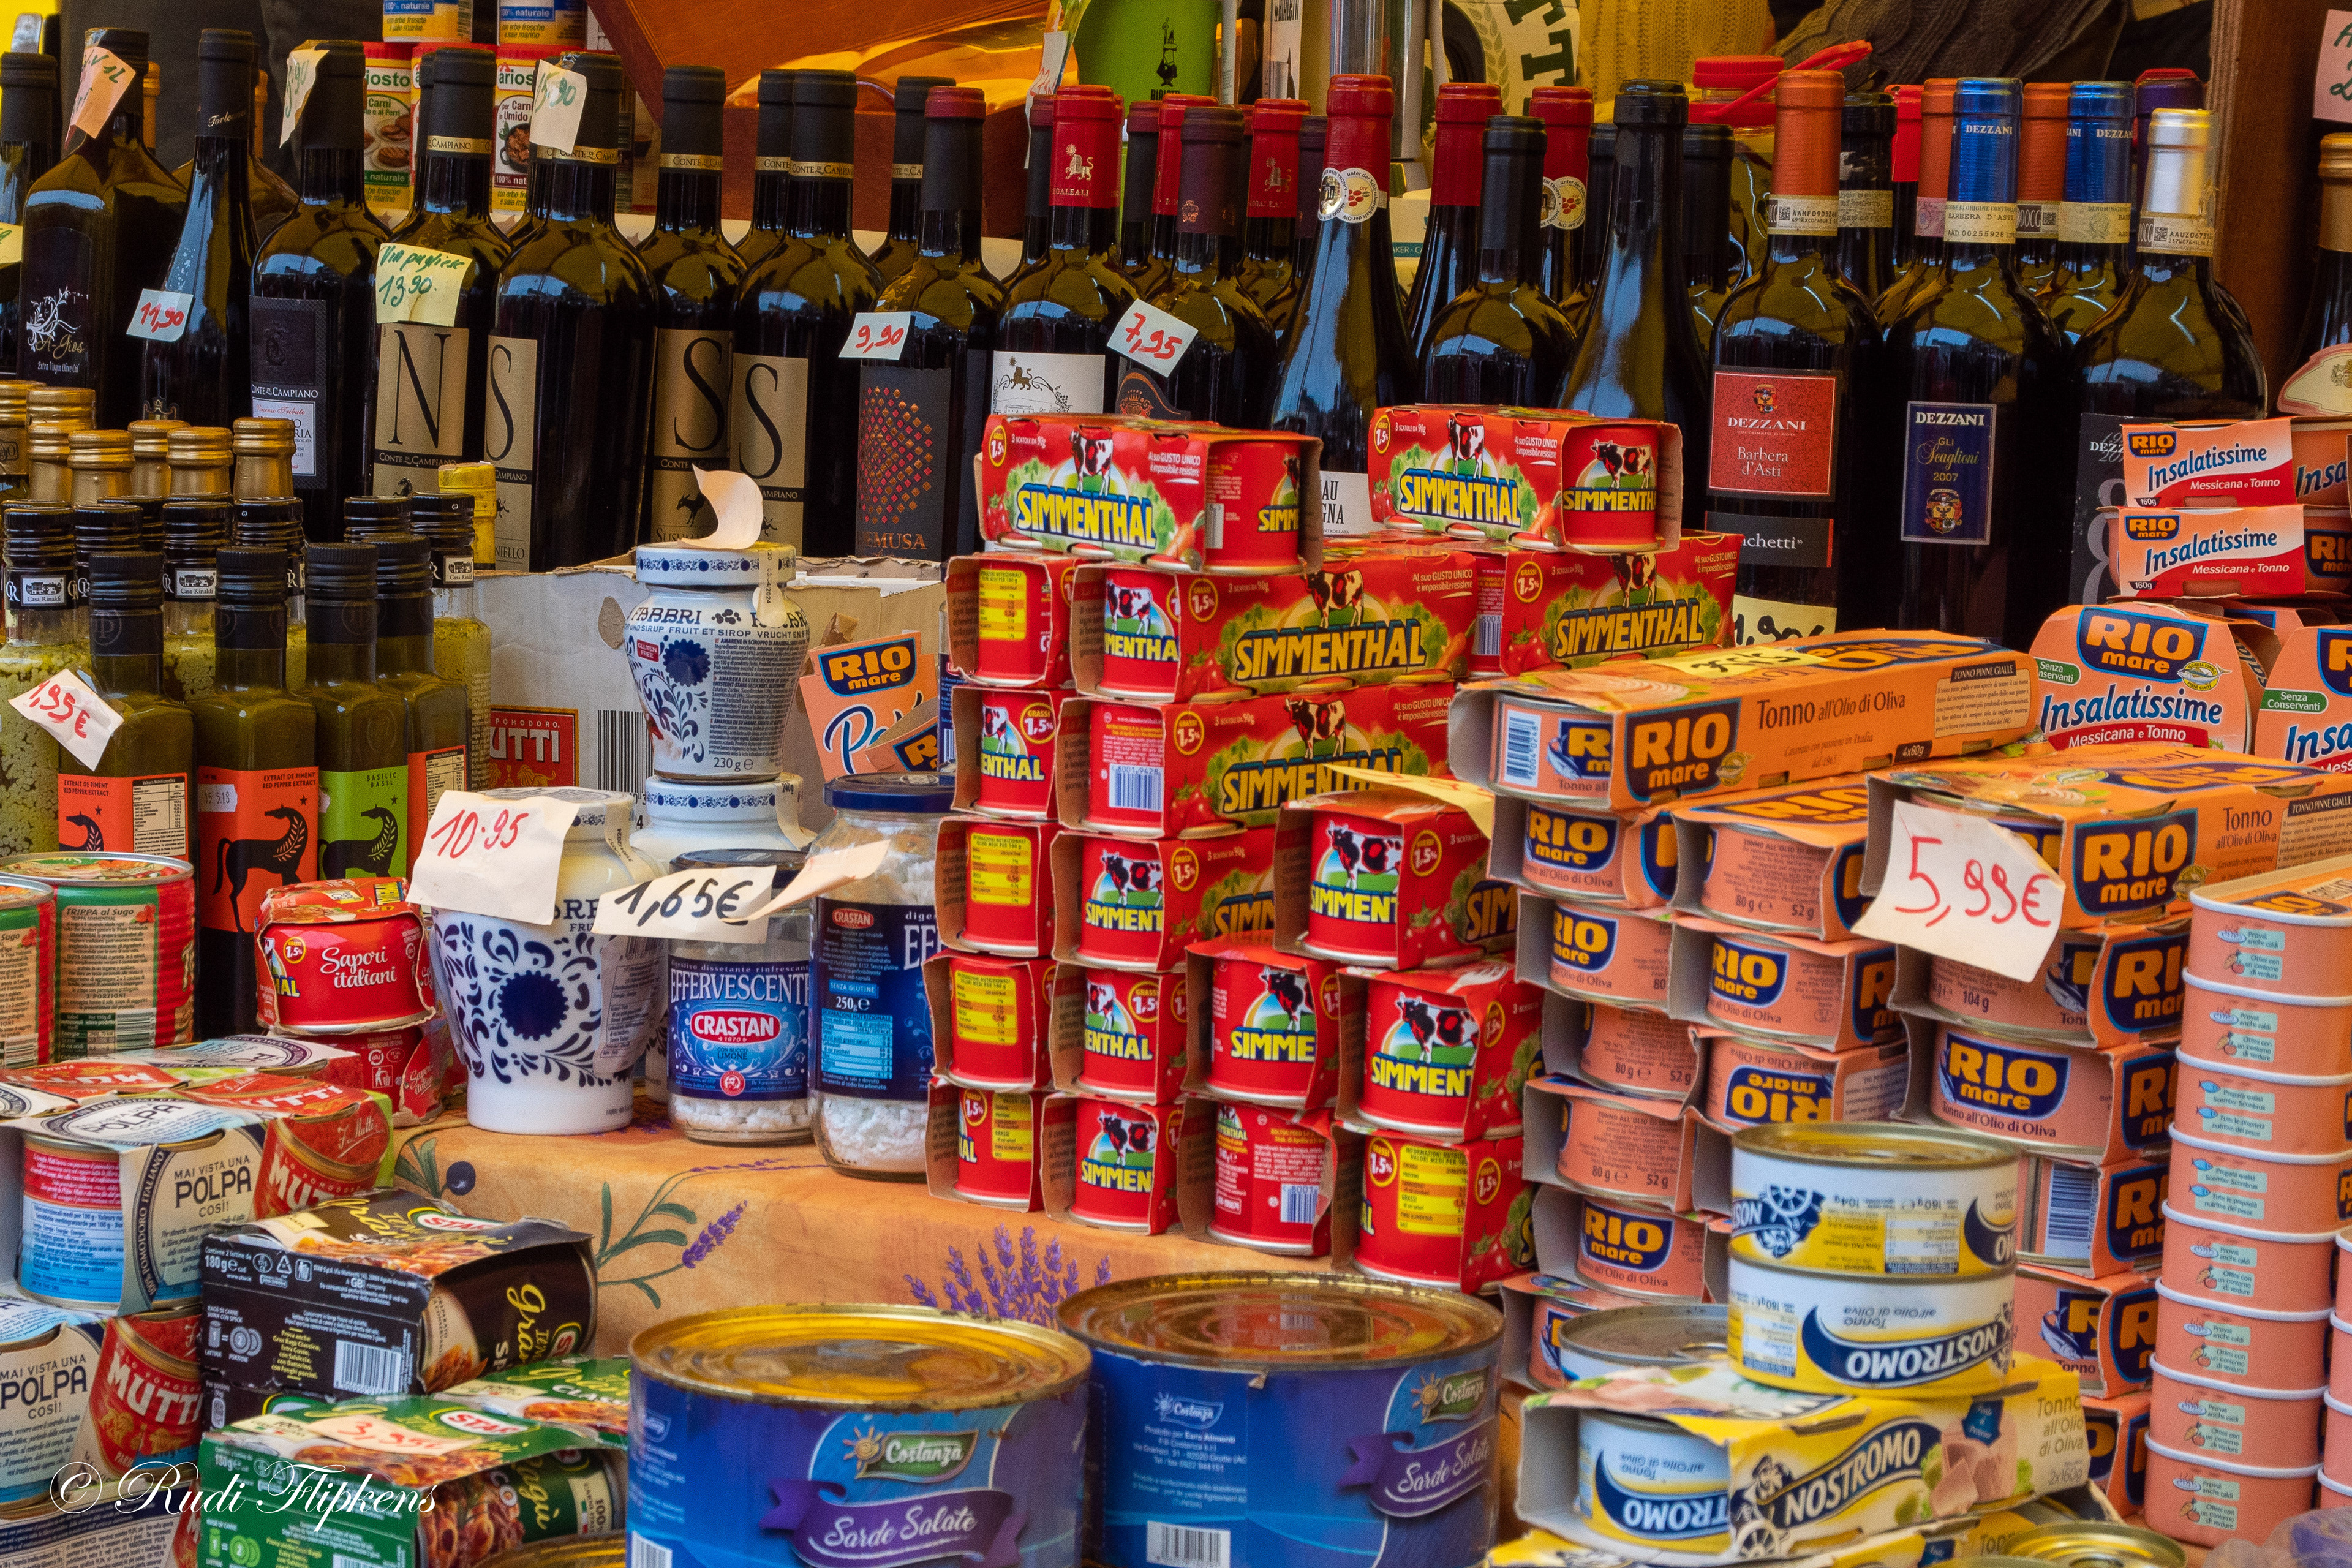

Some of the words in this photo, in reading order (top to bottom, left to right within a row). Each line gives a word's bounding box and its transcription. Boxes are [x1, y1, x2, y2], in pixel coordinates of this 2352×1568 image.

[516, 9, 549, 17] naturale
[369, 99, 391, 107] Carni
[1966, 124, 2013, 135] DEZZANI
[2097, 129, 2132, 138] DEZZAN
[673, 156, 701, 167] CONTE
[140, 301, 184, 330] 11,90
[856, 325, 904, 353] 9,90
[1125, 312, 1183, 360] 7,95
[251, 384, 265, 395] CONTE
[273, 387, 318, 398] CAMPIANO
[388, 328, 452, 448] N
[675, 337, 723, 452] S
[486, 344, 511, 461] S
[739, 363, 778, 479] S
[1728, 417, 1806, 431] DEZZANI
[1915, 412, 1985, 427] DEZZANI
[1917, 439, 1980, 466] Scaglioni
[1938, 437, 1954, 447] GLI
[2132, 435, 2174, 449] RIO
[2140, 447, 2167, 455] mare
[1738, 446, 1789, 463] Barbera
[1741, 462, 1782, 477] d'Asti
[1933, 472, 1959, 482] 2007
[2149, 443, 2267, 492] Insalatissime
[2190, 479, 2243, 490] Messicana
[2249, 478, 2280, 488] Tonno
[1400, 474, 1521, 527] SIMMENTHAL
[2139, 497, 2157, 506] 160g
[1016, 489, 1156, 549] SIMMENTHAL
[2129, 518, 2177, 532] RIO
[2138, 530, 2168, 538] mare
[2145, 527, 2277, 576] Insalatissime
[1432, 571, 1452, 580] GUSTO
[1453, 569, 1472, 579] UNICO
[2192, 564, 2250, 575] Messicana
[2257, 563, 2290, 573] Tonno
[1518, 577, 1539, 594] 1,5%
[2135, 581, 2153, 590] 160g
[627, 607, 701, 625] FABBRI
[1556, 602, 1703, 658] SIMMENTHAL
[2086, 616, 2195, 662] RIO
[638, 642, 657, 652] GLUTEN
[1235, 626, 1427, 680] SIMMENTHAL
[828, 646, 911, 682] RIO
[1954, 669, 1975, 679] TONNO
[1976, 668, 1994, 677] PINNE
[1994, 665, 2014, 675] GIALLE
[2040, 660, 2064, 673] Senza
[2101, 651, 2170, 674] mare
[848, 673, 901, 690] mare
[2040, 682, 2223, 734] Insalatissime
[2267, 700, 2320, 711] Conservanti
[2280, 692, 2307, 702] Senza
[1756, 698, 1816, 731] Tonno
[1819, 698, 1858, 722] all'Olio
[1858, 695, 1871, 715] di
[1873, 690, 1906, 712] Oliva
[1632, 711, 1733, 769] RIO
[2068, 728, 2135, 748] Messicana
[2146, 725, 2187, 741] Tonno
[1902, 745, 1924, 757] 4x80g
[714, 757, 733, 768] 230
[263, 774, 284, 782] EXTRAIT
[295, 772, 315, 780] PIMENT
[295, 778, 316, 787] EXTRACT
[367, 772, 398, 783] BASILIC
[371, 778, 393, 788] BASIL
[1648, 761, 1711, 790] mare
[2223, 807, 2272, 831] Tonno
[1531, 812, 1608, 851] RIO
[2216, 834, 2244, 850] all'Olio
[2245, 833, 2252, 845] di
[2254, 831, 2277, 843] Oliva
[1535, 844, 1589, 865] mare
[2082, 825, 2188, 884] RIO
[1570, 873, 1581, 883] di
[1584, 873, 1613, 888] Oliva
[1894, 835, 2052, 928] 5,99€
[2100, 878, 2168, 903] mare
[614, 877, 753, 927] 1,65€
[1792, 903, 1804, 917] 52
[834, 912, 871, 925] CRASTAN
[320, 946, 388, 974] Sapori
[333, 967, 397, 989] italiani
[848, 984, 875, 993] GLUTINE
[695, 1016, 774, 1037] CRASTAN
[1949, 1049, 2058, 1096] RIO
[1961, 1081, 2032, 1112] mare
[142, 1152, 165, 1204] ITALIANO
[174, 1170, 198, 1182] MAI
[199, 1160, 227, 1175] VISTA
[228, 1156, 251, 1169] UNA
[175, 1166, 252, 1210] POLPA
[1584, 1203, 1664, 1245] RIO
[138, 1205, 154, 1274] POMODORO
[205, 1255, 227, 1272] 180g
[1591, 1240, 1644, 1266] mare
[1844, 1316, 1887, 1329] Tonno
[1846, 1322, 1997, 1380] NOSTROMO
[27, 1362, 59, 1376] VISTA
[61, 1354, 86, 1368] UNA
[1442, 1375, 1485, 1405] Costanza
[884, 1434, 963, 1467] Costanza
[1398, 1463, 1451, 1494] Sarde
[1784, 1427, 1922, 1527] NOSTROMO
[823, 1515, 895, 1550] Sarde
[901, 1504, 977, 1537] Salate
